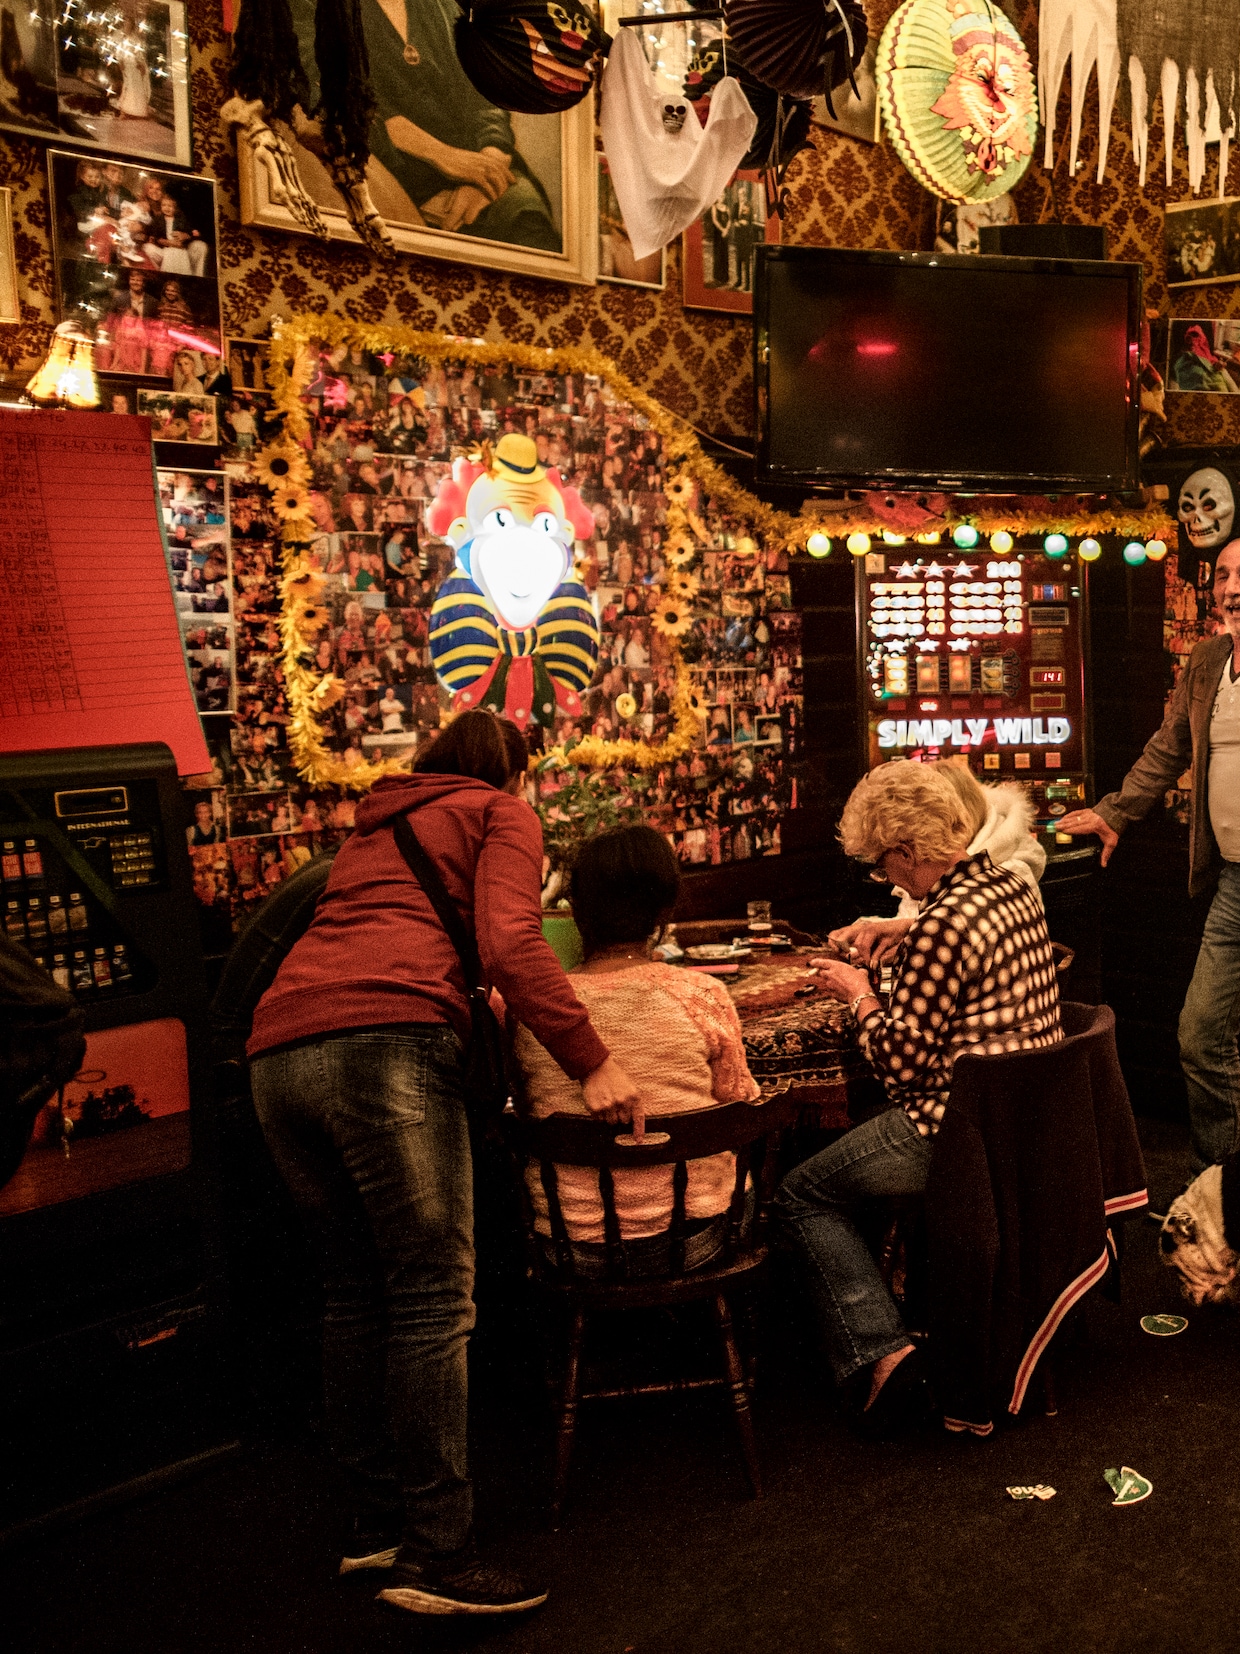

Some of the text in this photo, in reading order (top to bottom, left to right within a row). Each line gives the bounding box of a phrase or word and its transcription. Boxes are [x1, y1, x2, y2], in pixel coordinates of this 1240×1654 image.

[1043, 672, 1062, 682] 141
[877, 717, 1071, 747] SIMPLY WILD
[67, 819, 130, 831] INTERNATIONAL
